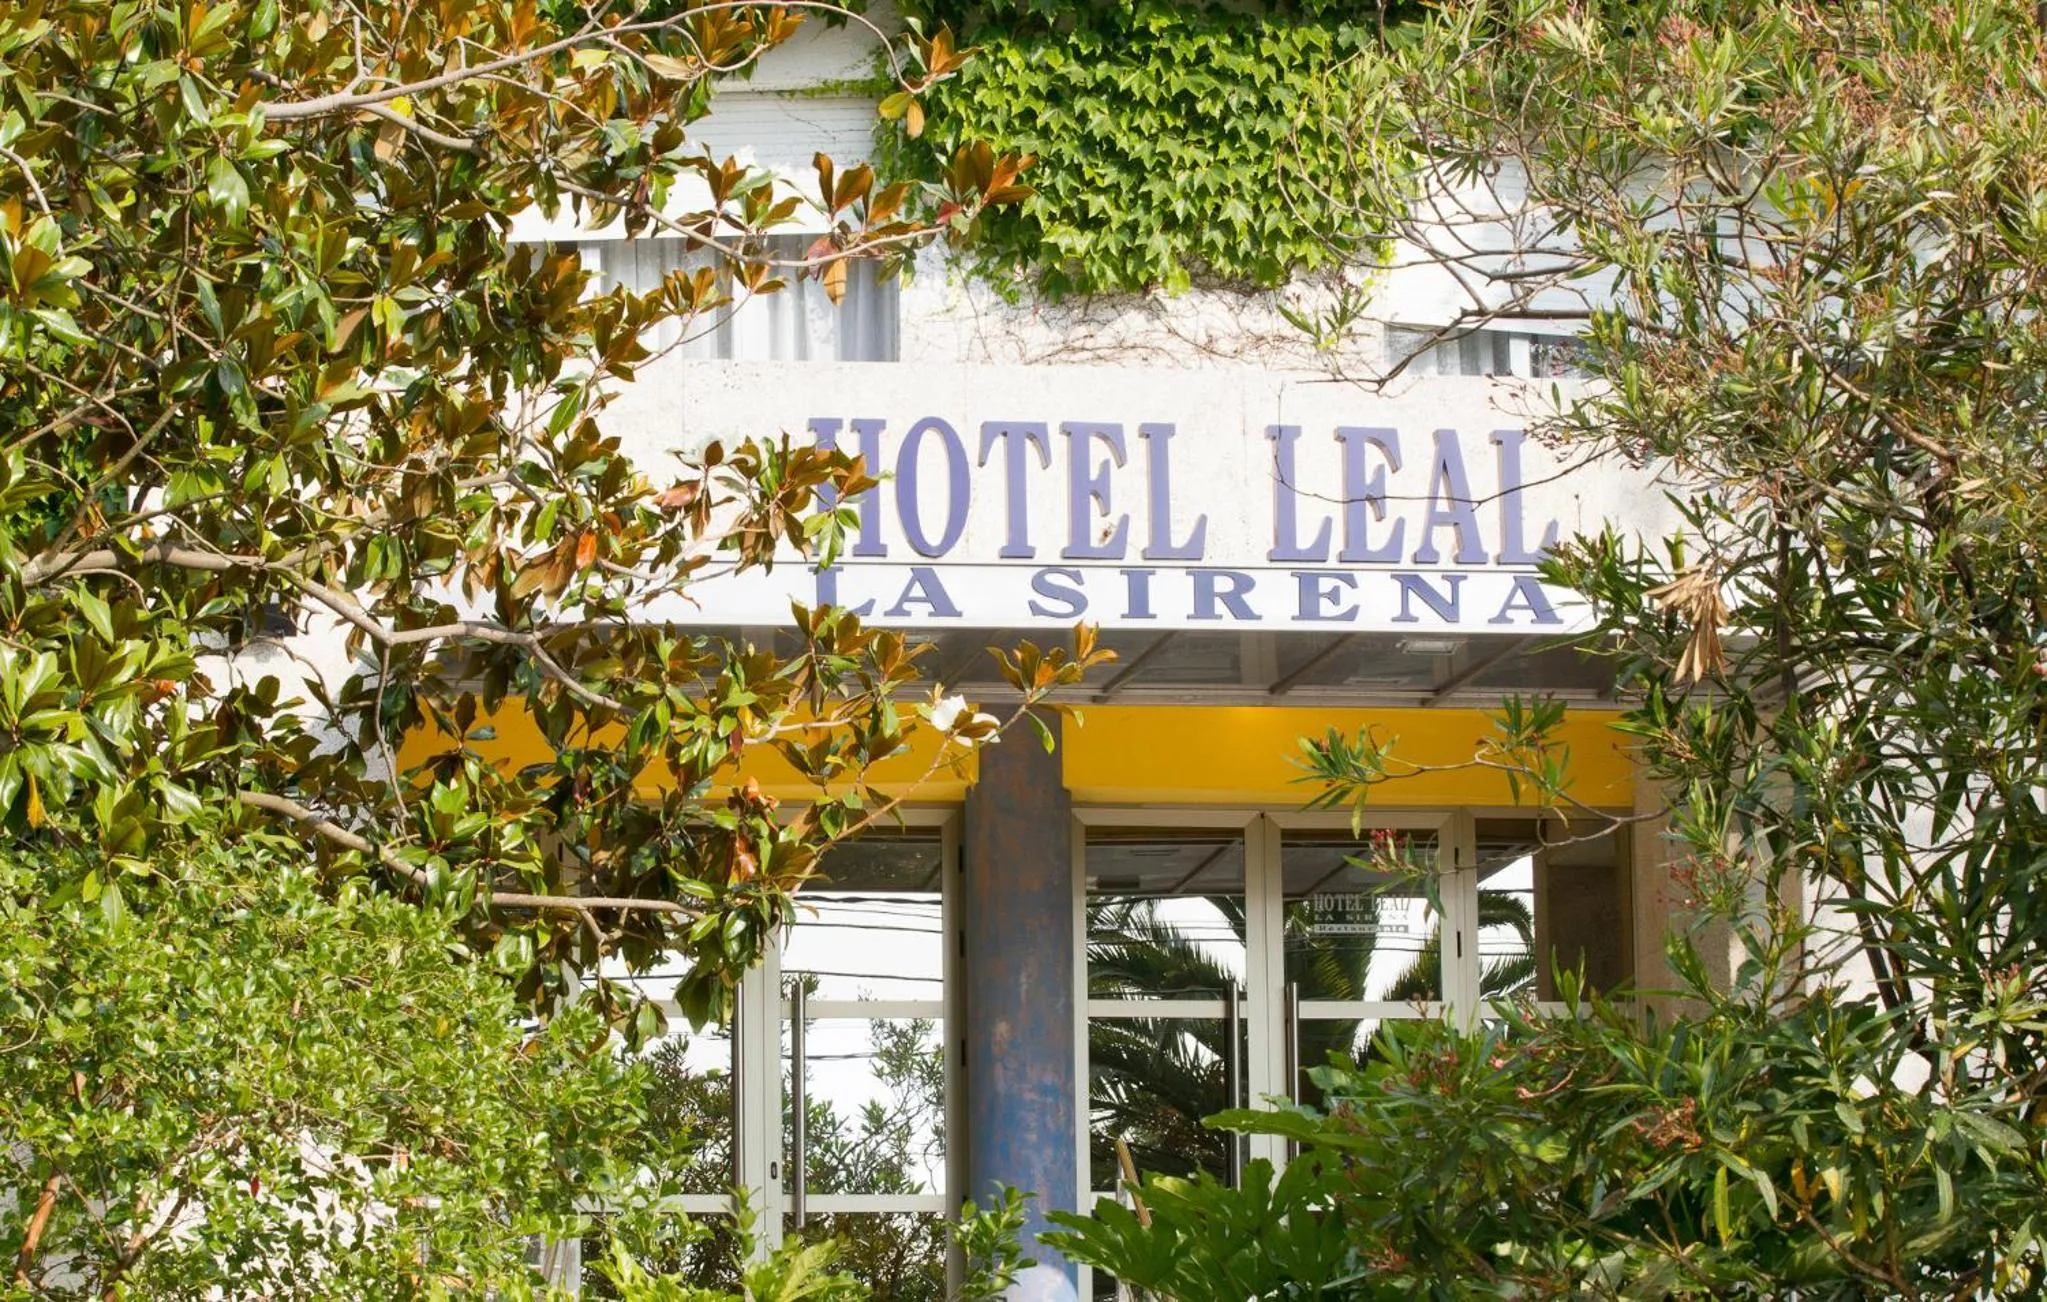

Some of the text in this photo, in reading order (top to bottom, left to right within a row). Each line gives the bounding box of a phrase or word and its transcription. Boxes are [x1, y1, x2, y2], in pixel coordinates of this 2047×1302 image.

[808, 416, 1559, 564] HOTEL LEAL
[808, 566, 1564, 624] LA SIRENA
[1314, 893, 1411, 912] HOTEL LEAL
